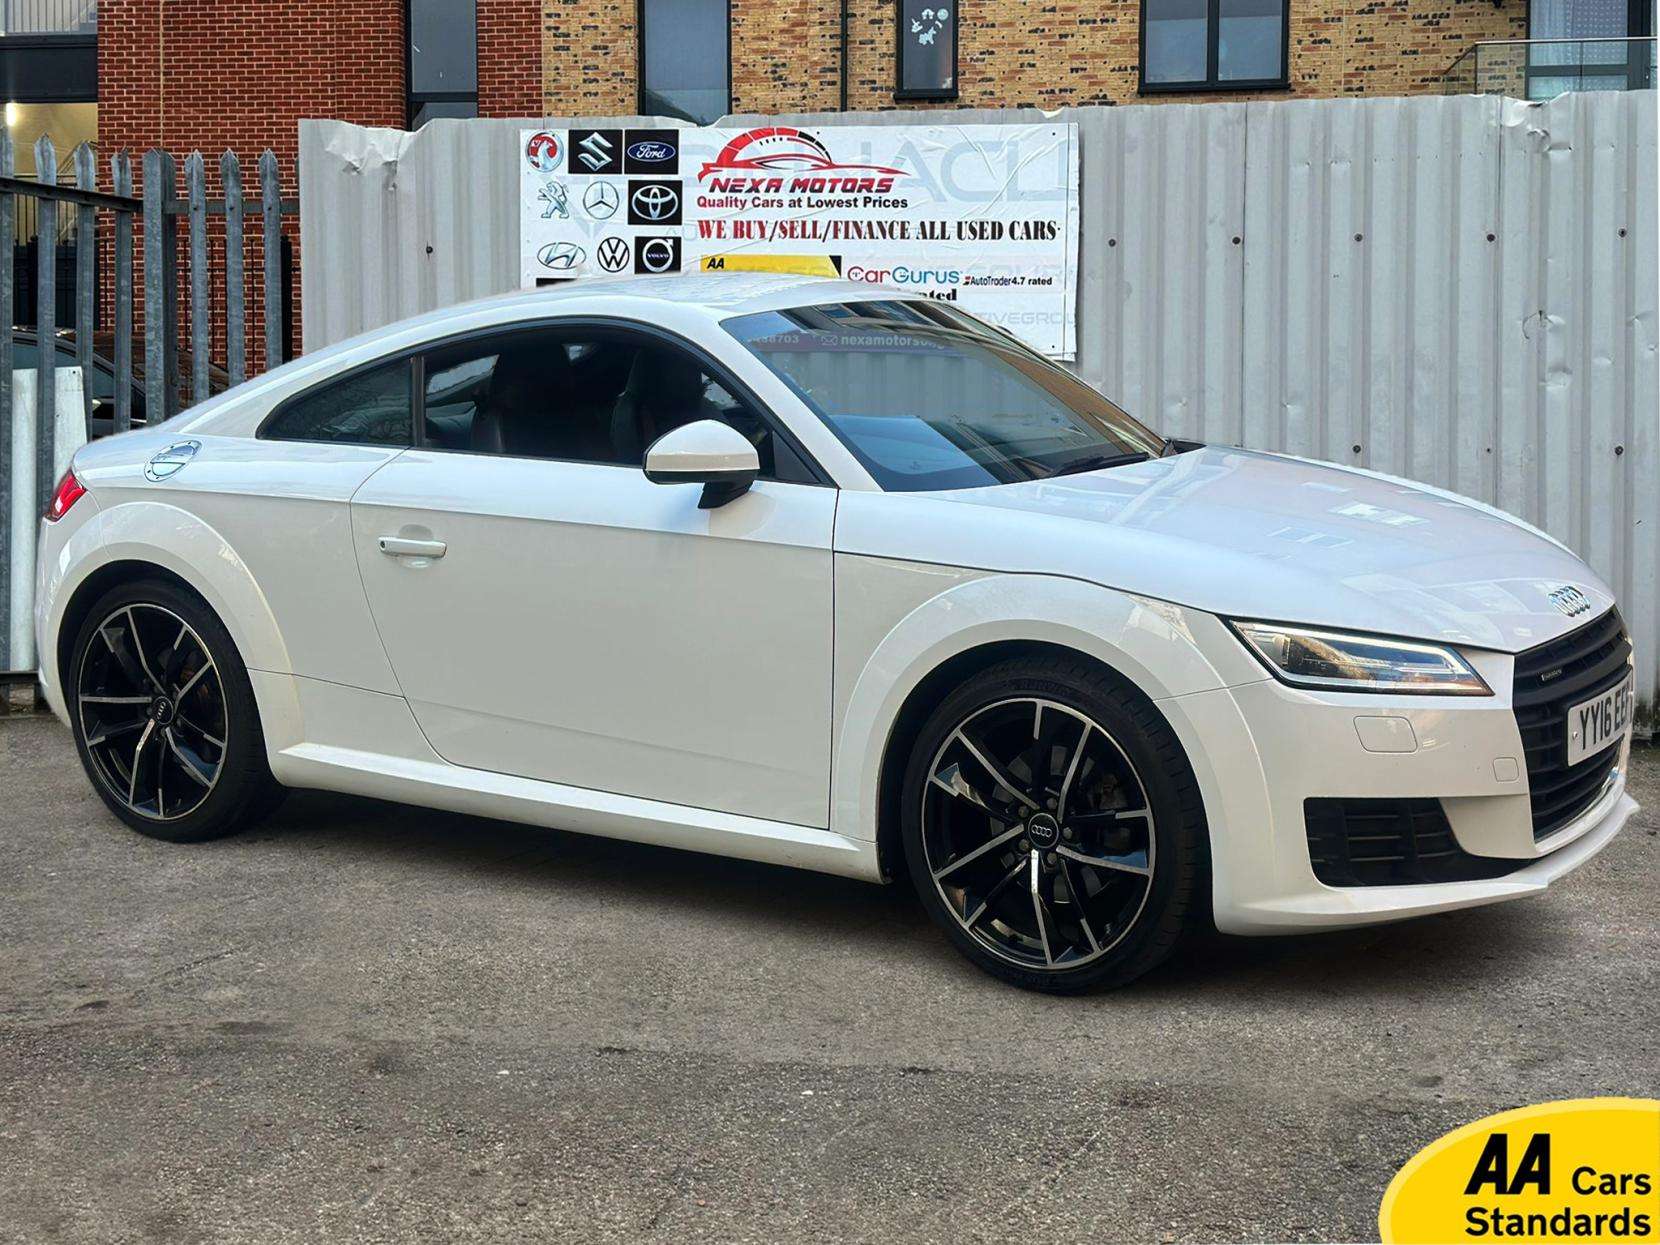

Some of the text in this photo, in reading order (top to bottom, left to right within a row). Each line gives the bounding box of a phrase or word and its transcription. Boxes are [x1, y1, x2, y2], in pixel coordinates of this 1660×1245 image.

[636, 144, 666, 158] Ford
[709, 177, 895, 194] NEXA MOTORS
[697, 196, 908, 211] Quality Cars at Lowest Prices
[697, 219, 727, 240] WE
[733, 219, 911, 243] BUY/SELL/FINANCE
[916, 219, 951, 240] ALL
[956, 220, 1004, 241] USED
[1008, 220, 1057, 241] CARS
[706, 257, 725, 269] AA
[847, 266, 961, 284] CarGurus
[1028, 276, 1053, 286] rated
[1580, 696, 1612, 751] YY16
